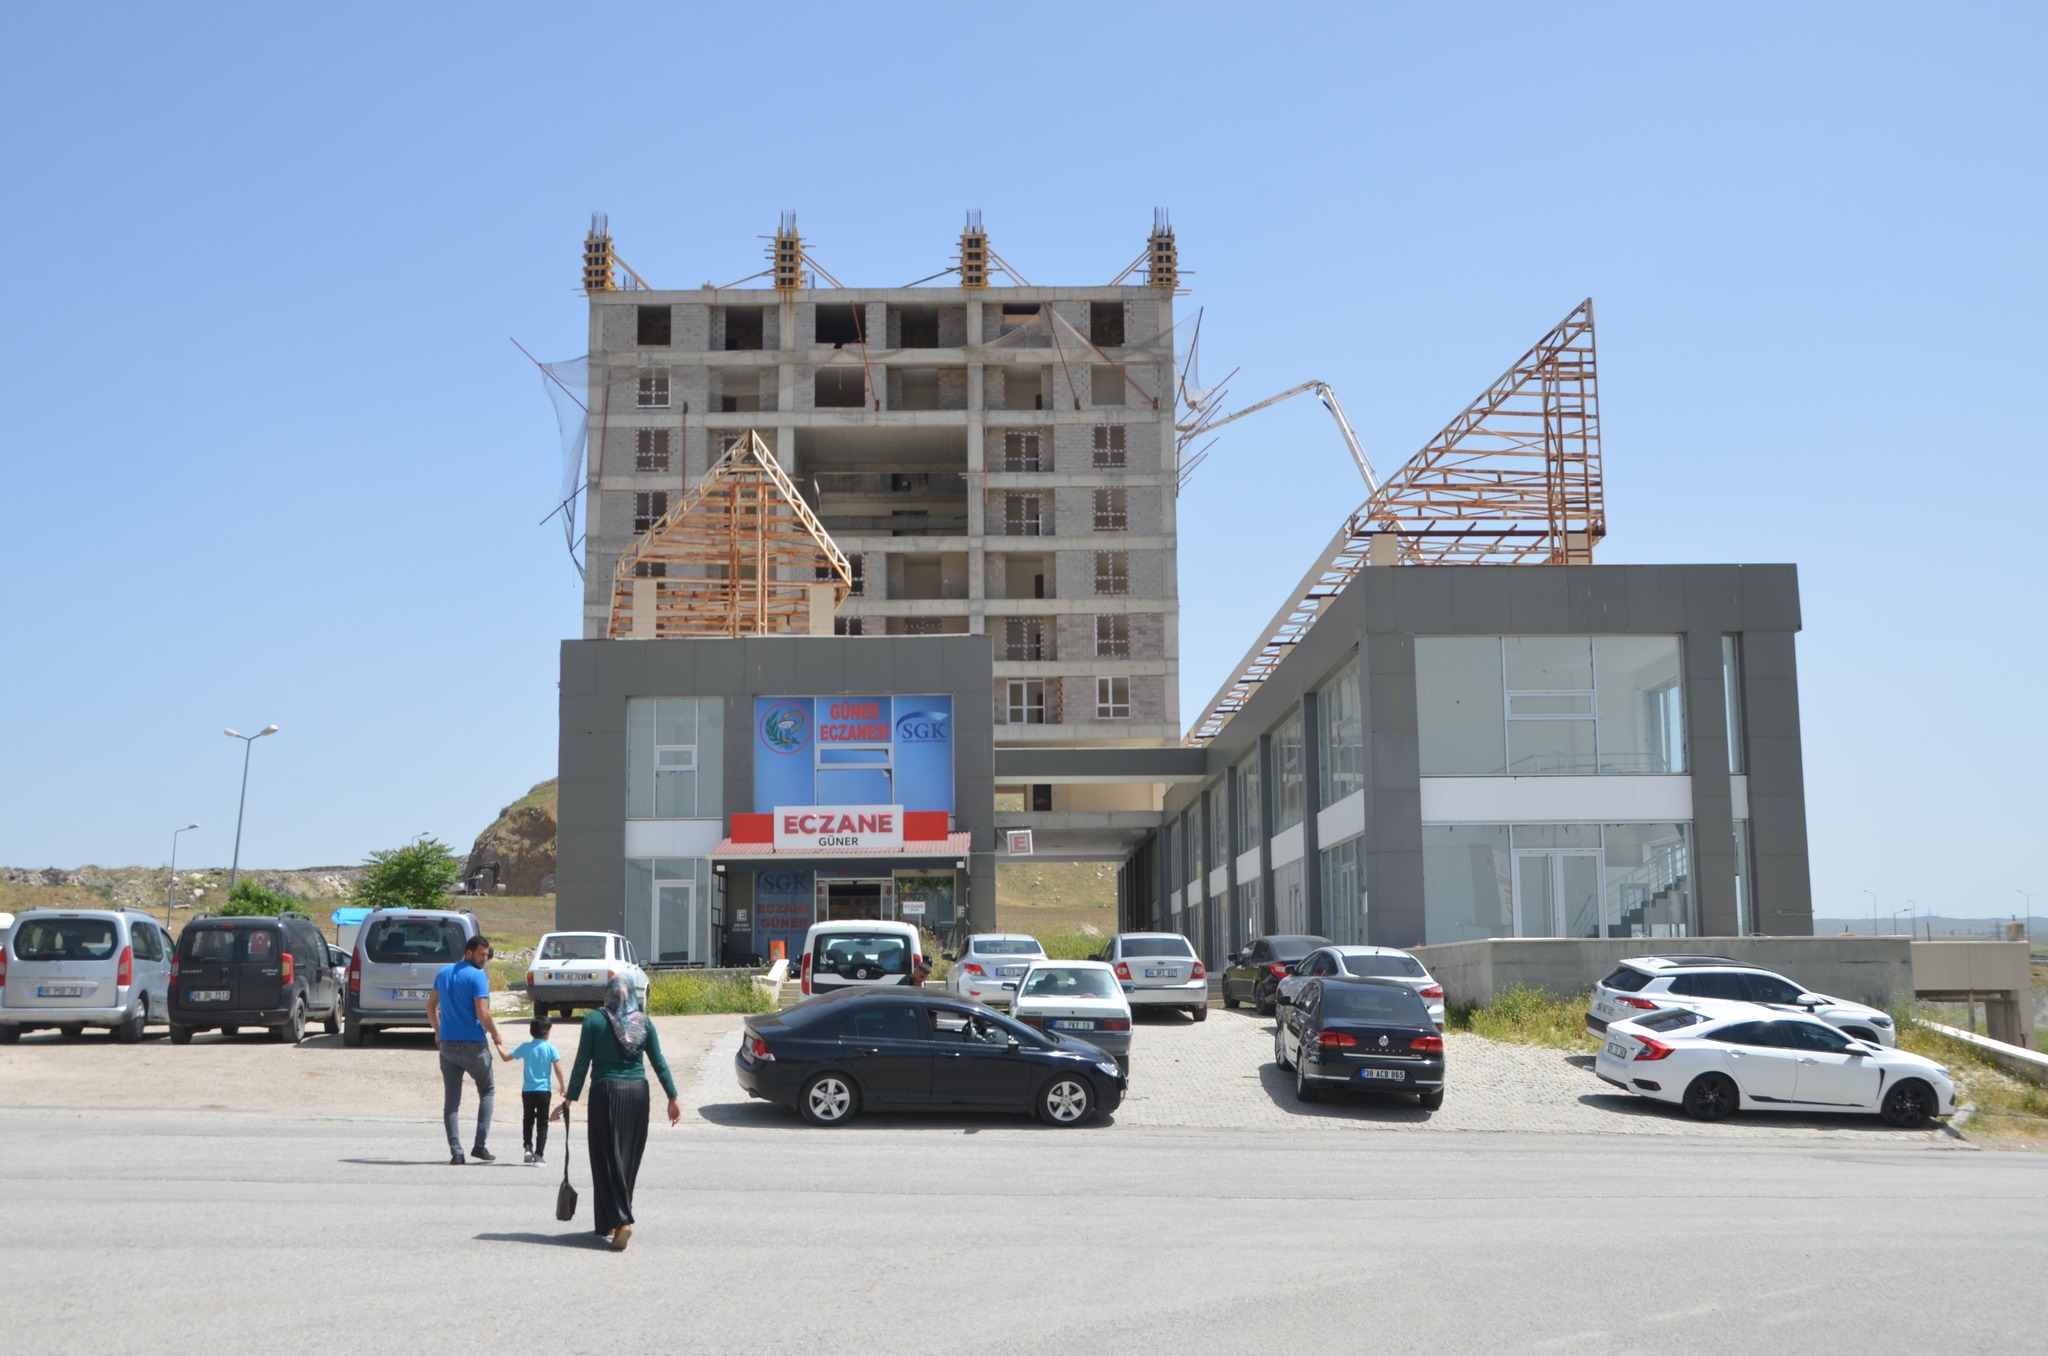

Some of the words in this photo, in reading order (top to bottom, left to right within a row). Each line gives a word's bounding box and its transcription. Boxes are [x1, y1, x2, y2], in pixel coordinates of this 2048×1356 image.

[830, 701, 879, 720] GÜNER
[820, 721, 889, 741] ECZANESİ
[902, 723, 946, 739] SGK
[784, 813, 893, 834] ECZANE
[818, 835, 858, 847] GÜNER
[1014, 836, 1026, 852] E
[763, 875, 807, 891] SGK
[757, 903, 811, 914] ECZANE
[760, 917, 808, 929] GÜNER
[1083, 1021, 1091, 1029] 19
[1365, 1069, 1374, 1077] 38
[1376, 1070, 1389, 1078] ACB
